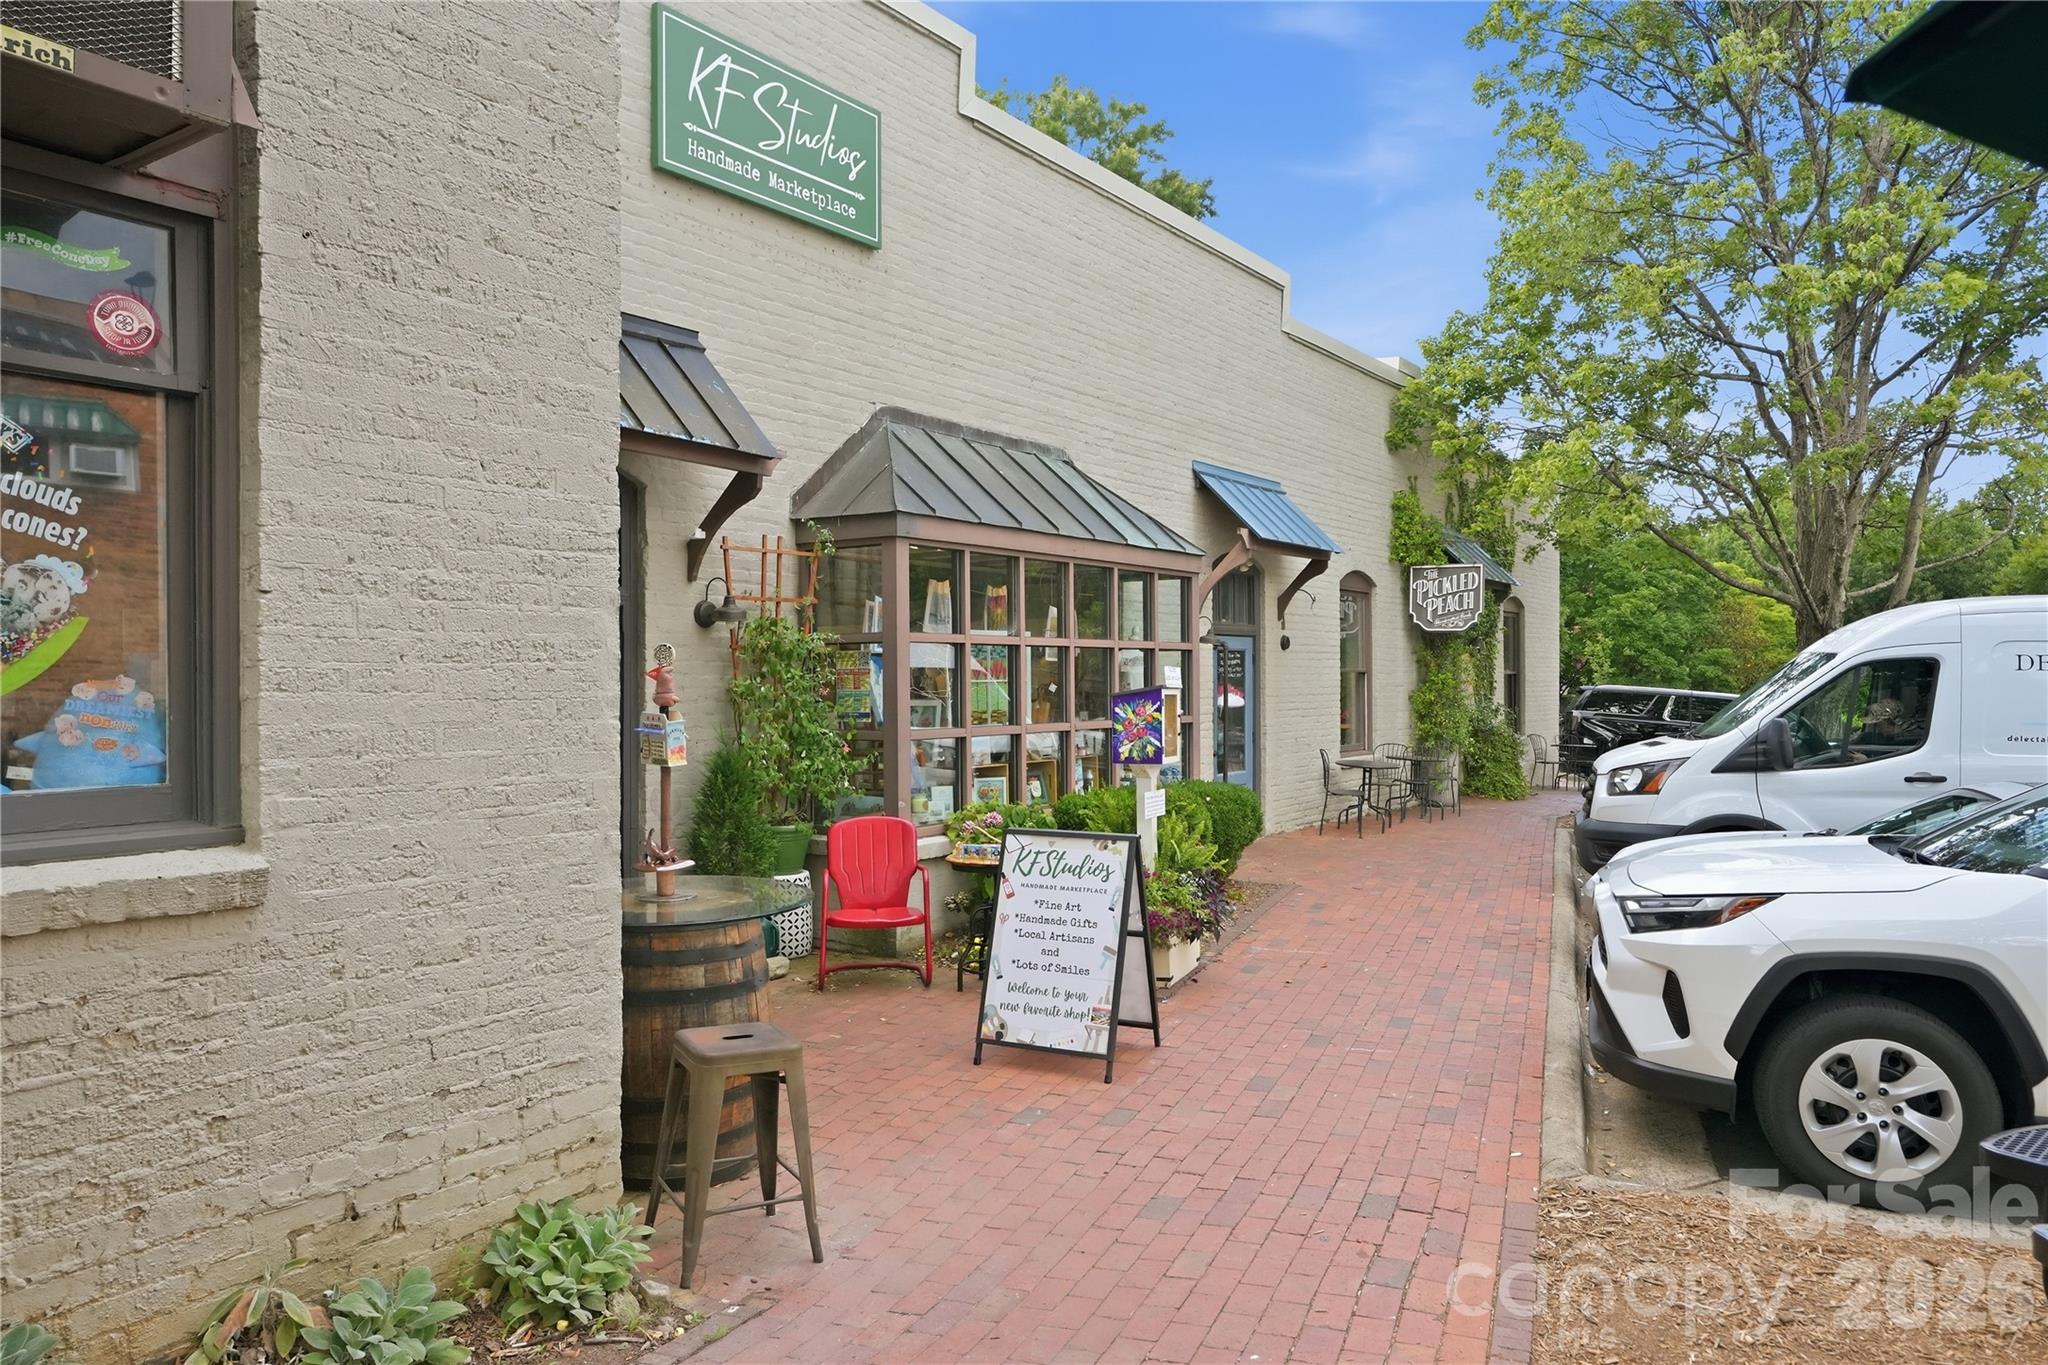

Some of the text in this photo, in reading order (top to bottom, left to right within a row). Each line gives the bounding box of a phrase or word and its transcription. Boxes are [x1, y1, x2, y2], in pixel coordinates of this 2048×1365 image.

[0, 36, 72, 72] rich
[688, 46, 867, 182] KF Studios
[687, 138, 857, 220] Handmade Marketplace
[0, 471, 82, 516] clouds
[1, 508, 88, 550] cones?
[1412, 571, 1480, 606] PICKLED
[1422, 591, 1475, 623] PEACH
[2007, 735, 2048, 743] delecta
[1020, 882, 1108, 895] HANDMADE MARKETPLACE
[1064, 902, 1082, 912] Art
[1070, 917, 1098, 929] Gifts
[1049, 931, 1095, 945] Artisans
[1040, 947, 1060, 957] and
[1041, 962, 1054, 972] of
[1054, 963, 1091, 976] Smiles
[1007, 981, 1089, 1002] Welcome to your
[999, 1001, 1091, 1022] new favorite shop!
